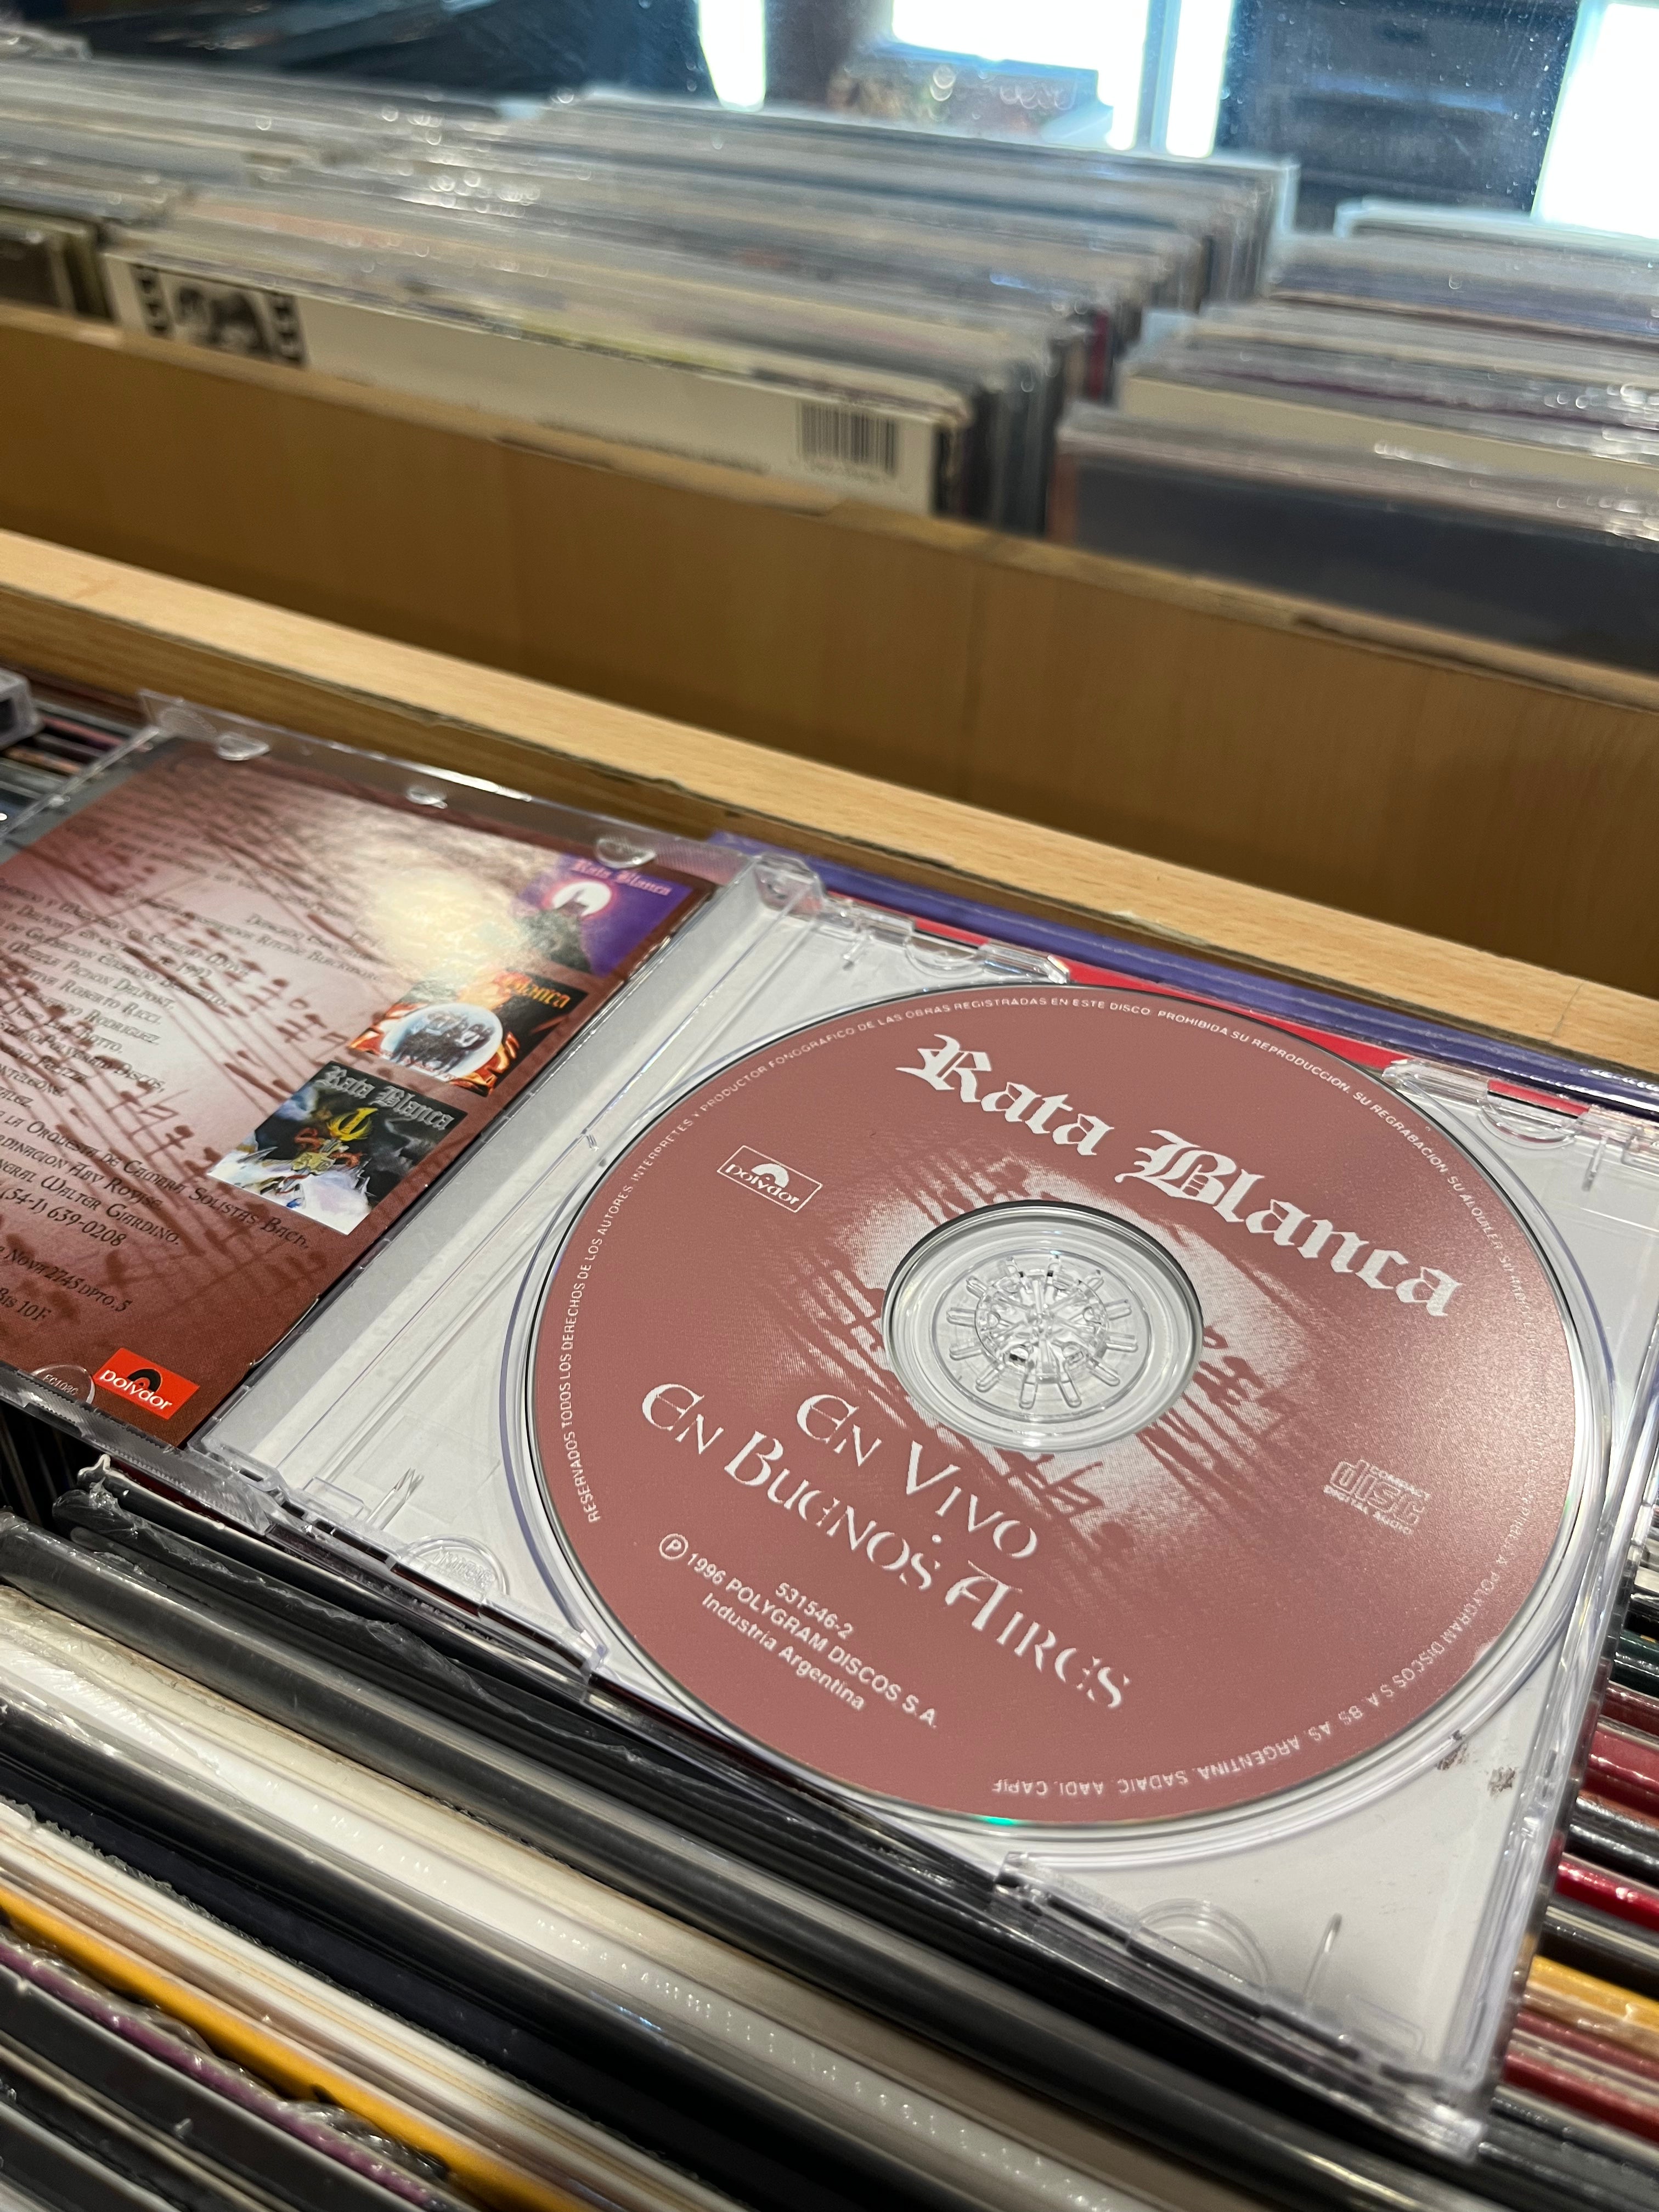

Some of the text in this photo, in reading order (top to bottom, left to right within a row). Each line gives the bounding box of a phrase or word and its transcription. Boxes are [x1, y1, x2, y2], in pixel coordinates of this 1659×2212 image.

[878, 1013, 902, 1026] LAS
[905, 1004, 951, 1019] OBRAS
[953, 997, 1047, 1011] REGISTRADAS
[1051, 997, 1068, 1006] EN
[1072, 998, 1105, 1009] ESTE
[857, 1020, 876, 1031] DE
[1157, 1010, 1228, 1036] PROHIBIDA
[1229, 1030, 1250, 1043] SU
[768, 1027, 855, 1068] FONOGRAFICO
[315, 1065, 455, 1131] Rata Blanca
[699, 1065, 768, 1111] PRODUCTOR
[1353, 1091, 1373, 1106] SU
[1369, 1103, 1449, 1173] REGRABACION
[40, 1175, 103, 1211] WALTER
[724, 1164, 800, 1205] polydor
[895, 1034, 1463, 1317] Rata Blanca
[1447, 1175, 1465, 1192] SU
[47, 1206, 127, 1246] 639-0208
[597, 1184, 634, 1235] AUTORES
[584, 1238, 602, 1261] LOS
[577, 1264, 591, 1279] DE
[561, 1283, 586, 1351] DERECHOS
[559, 1353, 572, 1380] LOS
[99, 1369, 173, 1412] polydor
[559, 1382, 573, 1429] TODOS
[563, 1431, 601, 1523] RESERVADOS
[905, 1440, 1037, 1559] VIVO
[687, 1553, 726, 1585] 1996
[725, 1577, 829, 1652] POLYGRAM
[827, 1645, 901, 1701] DISCOS
[775, 1582, 854, 1640] 531546-2
[702, 1592, 865, 1712] Industria Argentina
[1392, 1640, 1445, 1688] DISCOS
